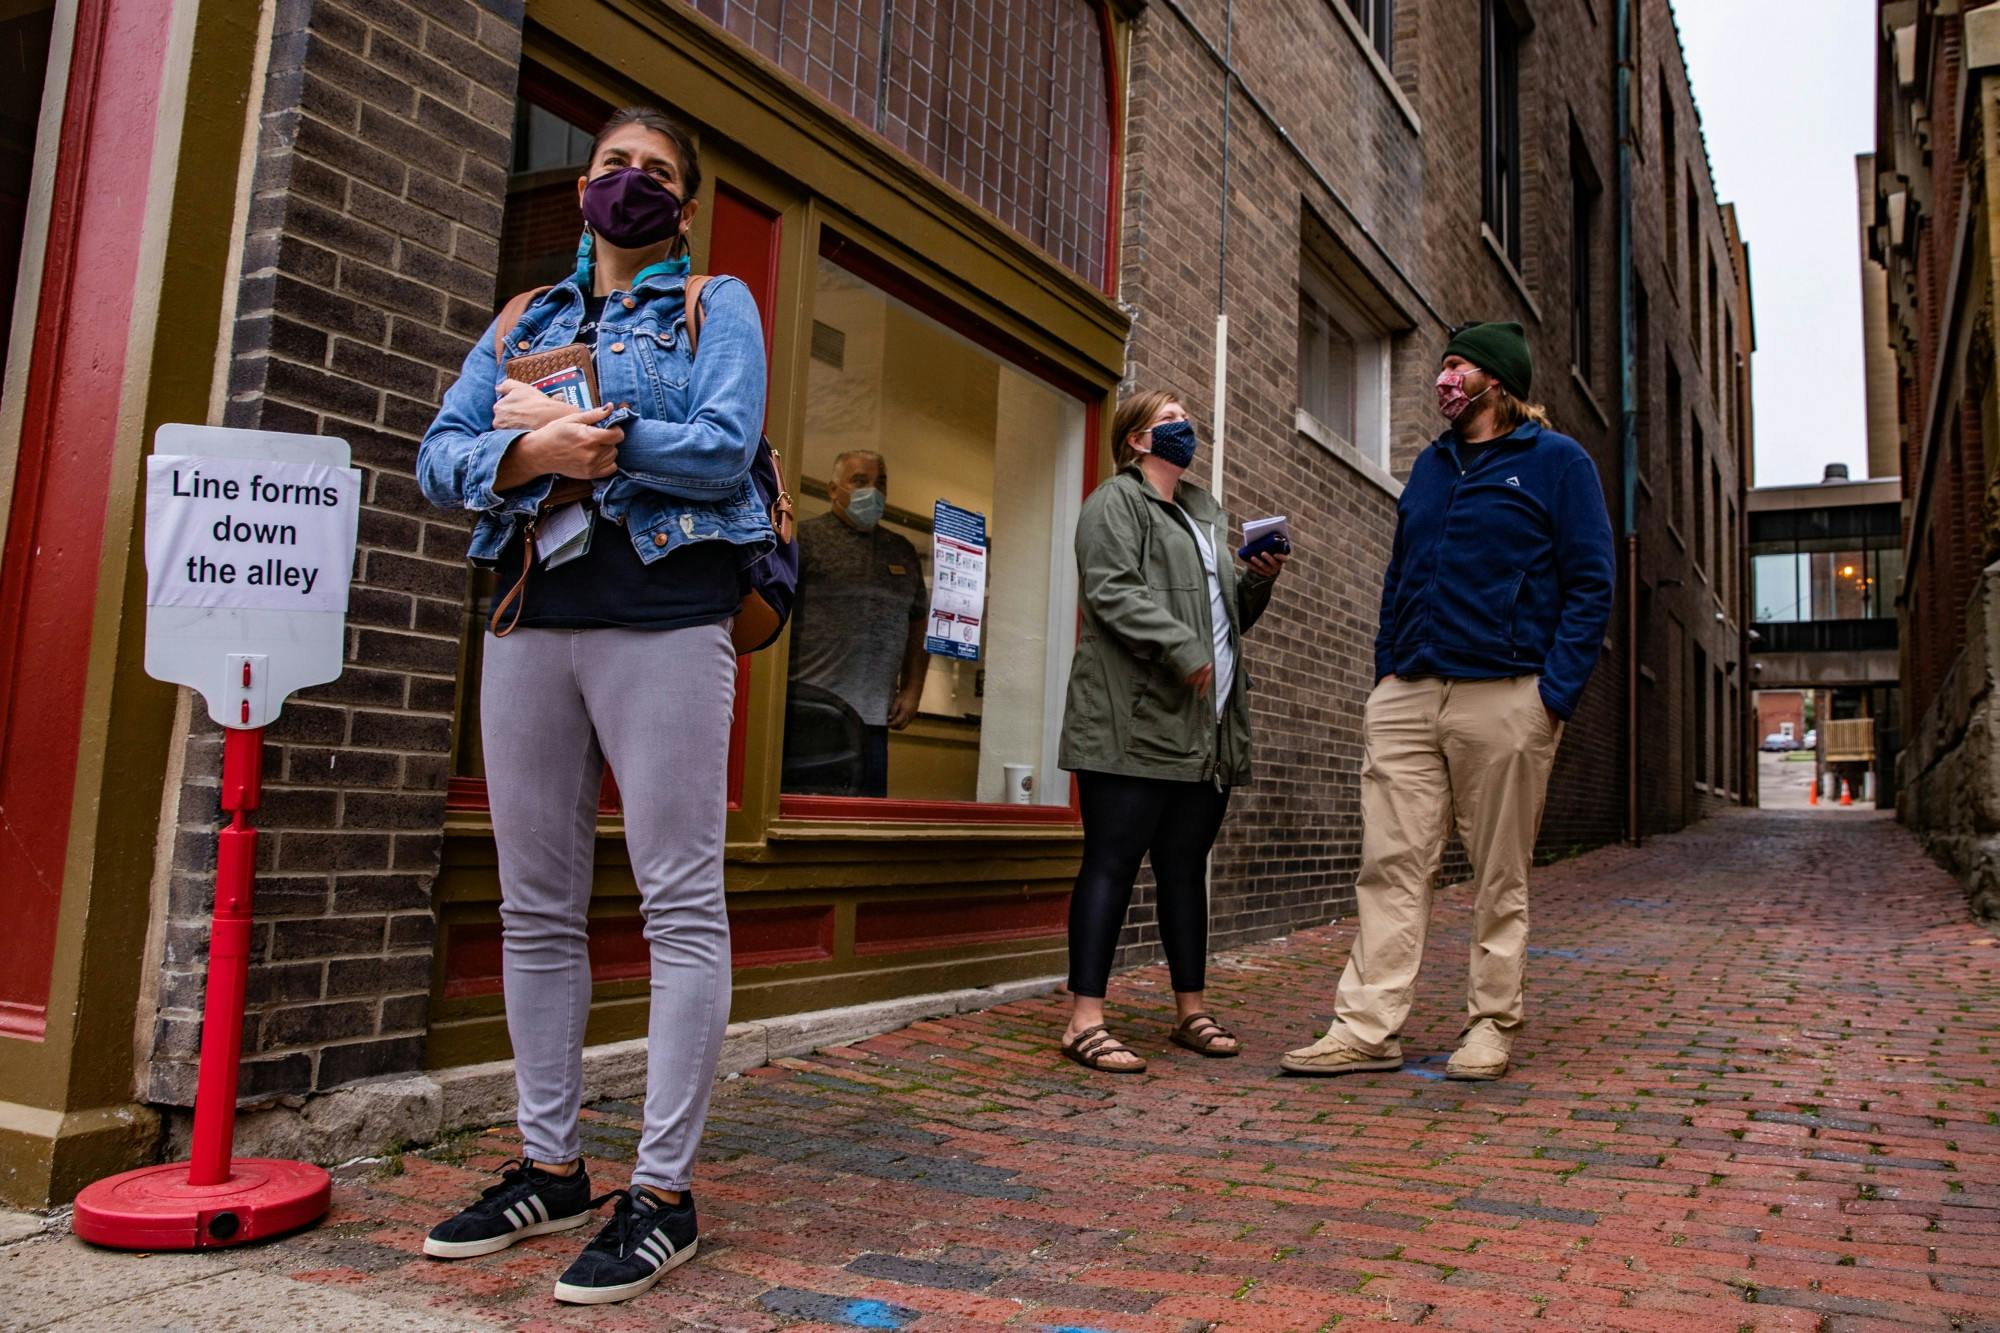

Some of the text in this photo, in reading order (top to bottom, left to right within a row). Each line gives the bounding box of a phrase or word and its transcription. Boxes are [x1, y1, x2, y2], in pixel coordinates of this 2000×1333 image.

[173, 469, 339, 507] Line forms
[212, 514, 297, 546] down
[186, 555, 319, 595] the alley
